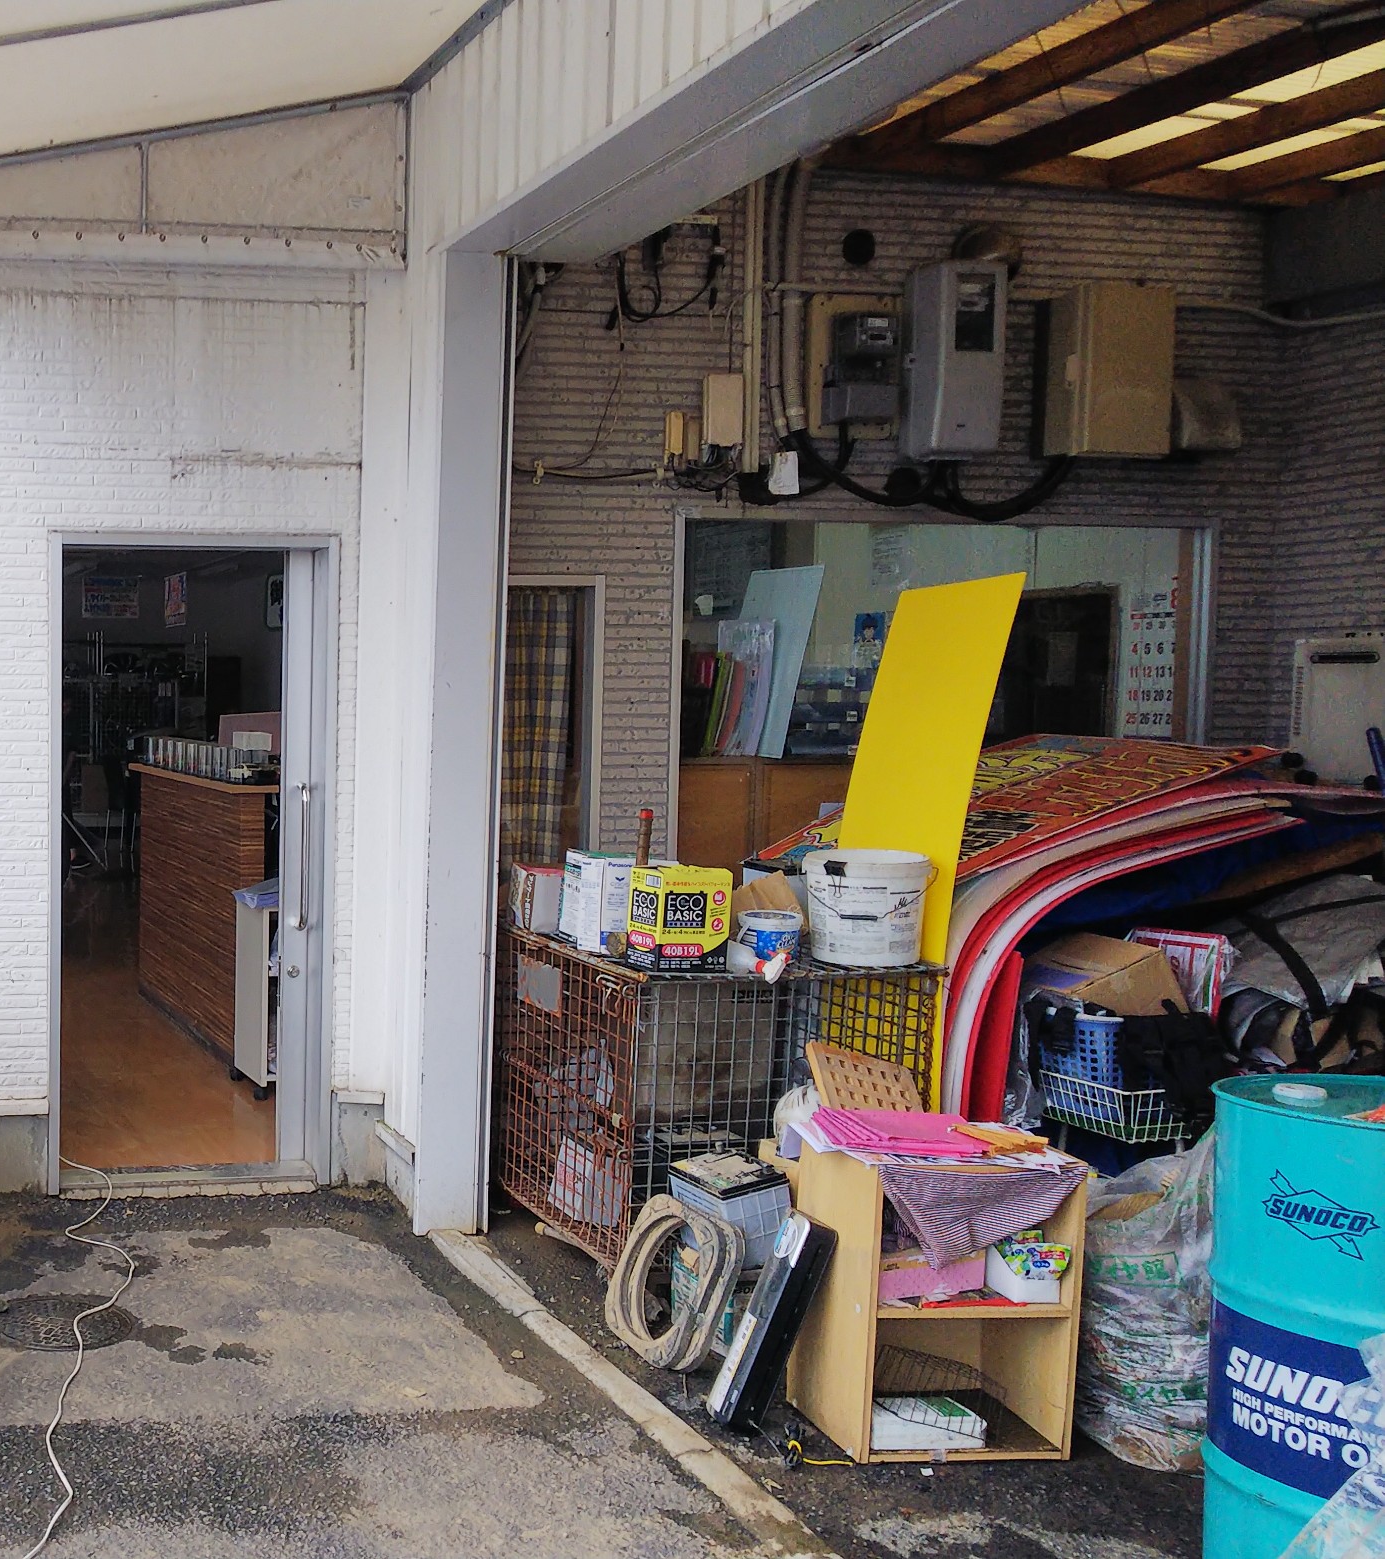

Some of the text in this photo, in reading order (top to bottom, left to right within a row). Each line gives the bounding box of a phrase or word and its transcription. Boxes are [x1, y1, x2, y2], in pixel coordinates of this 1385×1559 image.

[1131, 642, 1138, 655] 4
[1144, 642, 1151, 655] 5
[1157, 642, 1164, 655] 6
[1129, 667, 1139, 678] 11
[1143, 666, 1152, 678] 12
[1155, 666, 1165, 678] 13
[1128, 690, 1138, 701] 18
[1141, 690, 1151, 701] 19
[1153, 689, 1164, 701] 20
[1126, 712, 1137, 724] 25
[1139, 712, 1150, 725] 26
[1152, 712, 1163, 725] 27
[633, 891, 657, 909] ECO
[667, 895, 704, 910] ECO
[632, 905, 656, 920] BASIC
[666, 911, 703, 921] BASIC
[631, 934, 653, 947] 40B19L
[664, 947, 699, 956] 40B19L
[1269, 1198, 1369, 1232] SUNOCO
[1232, 1387, 1261, 1411] HIGH
[1232, 1402, 1330, 1460] MOTOR
